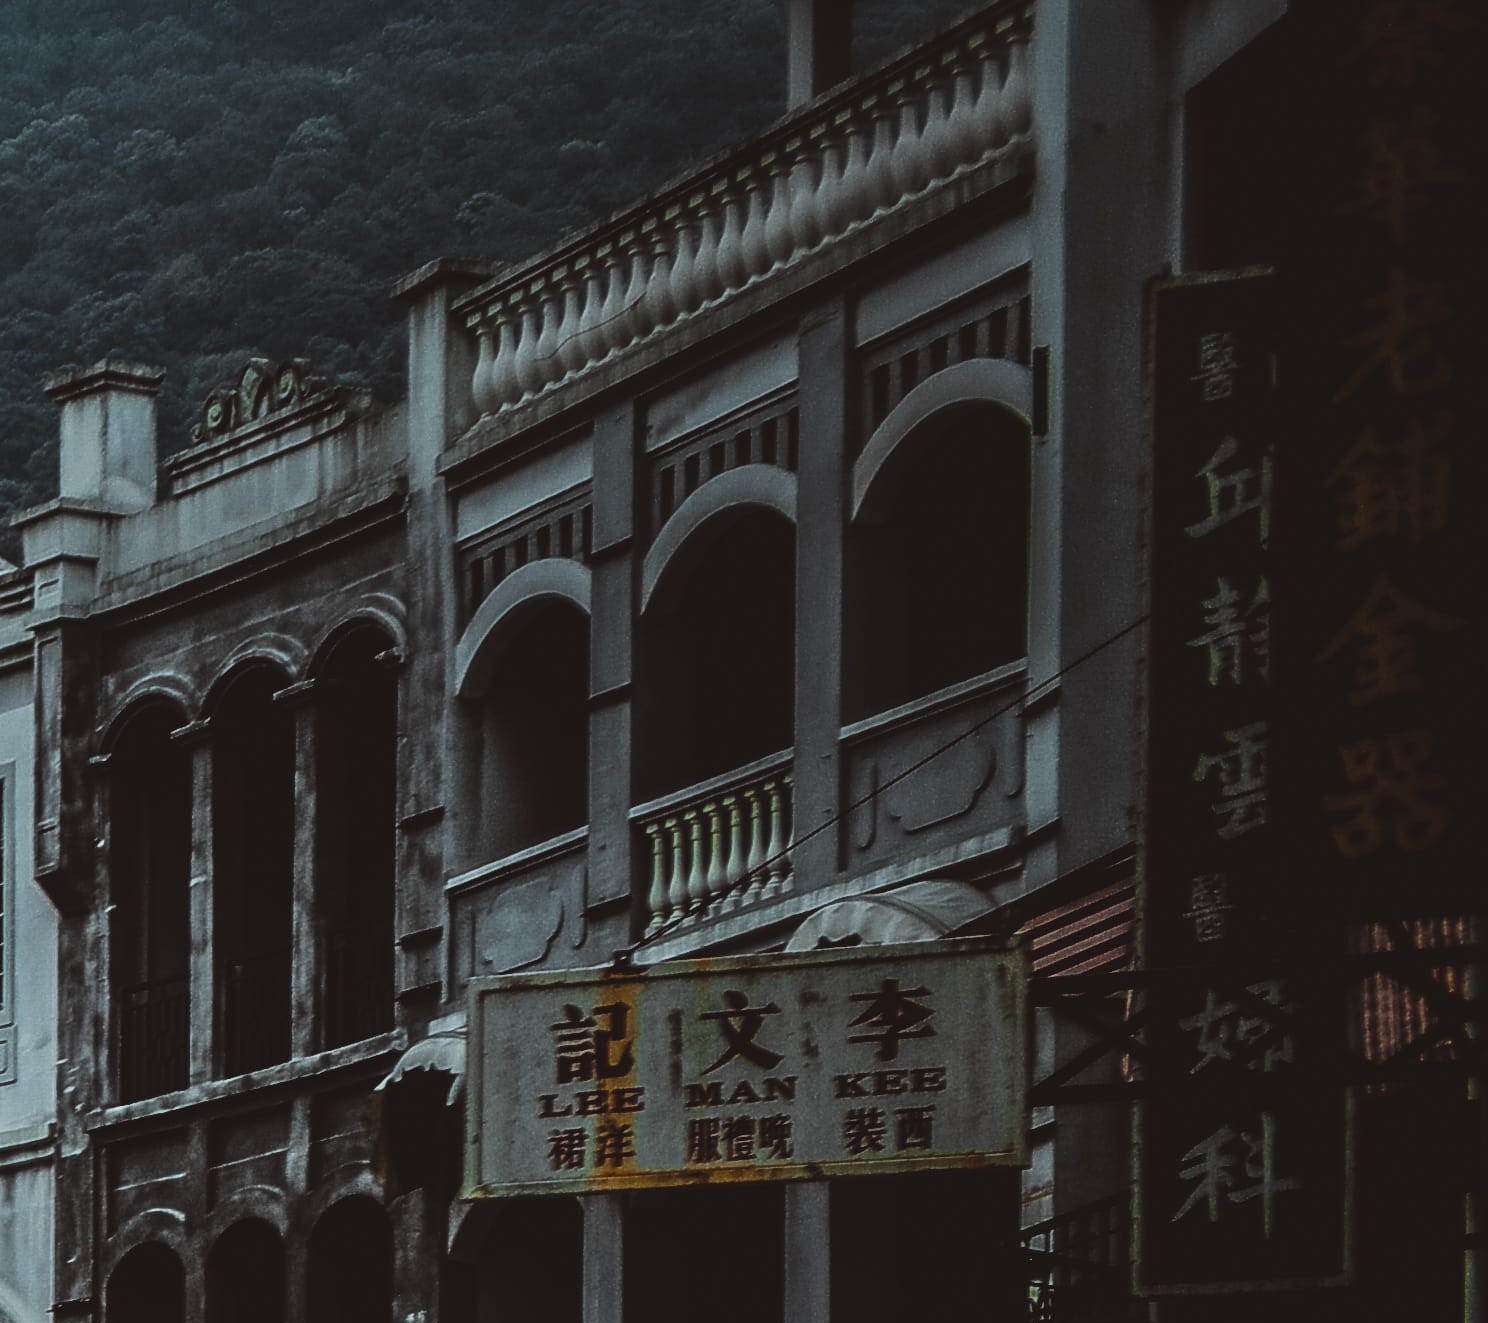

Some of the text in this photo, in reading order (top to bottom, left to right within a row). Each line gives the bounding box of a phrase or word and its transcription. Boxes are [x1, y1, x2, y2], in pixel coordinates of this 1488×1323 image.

[537, 1065, 948, 1121] LEE MAN KEE
